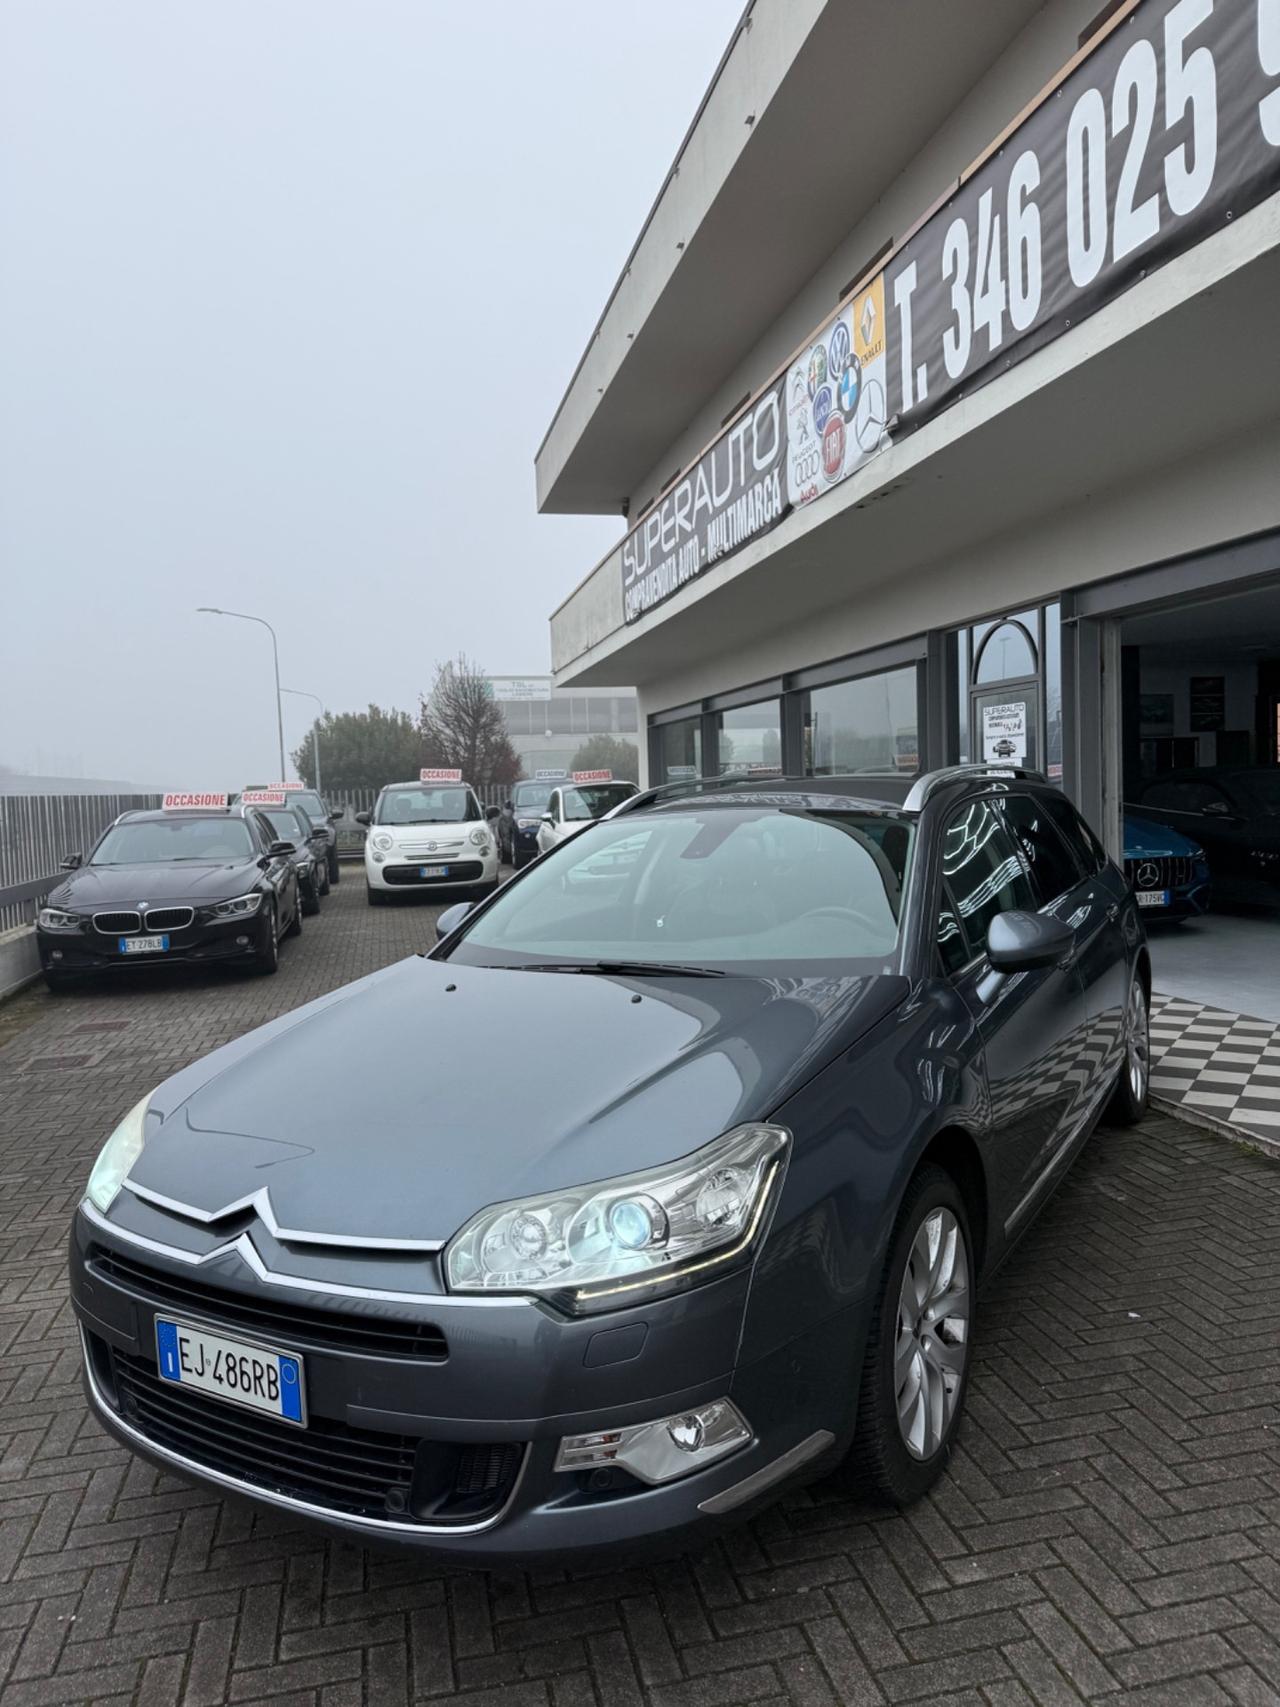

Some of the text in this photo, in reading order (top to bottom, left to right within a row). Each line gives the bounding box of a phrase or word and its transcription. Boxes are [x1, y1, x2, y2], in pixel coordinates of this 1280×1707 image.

[895, 261, 928, 412] T.
[942, 150, 1042, 379] 346
[1066, 0, 1217, 288] 025
[623, 391, 780, 586] SUPERAUTO
[707, 467, 782, 563] MULTIMARCA
[165, 794, 226, 806] OCCASIONE
[243, 793, 284, 802] OCCASIONE
[179, 1337, 205, 1377] EJ
[212, 1350, 280, 1401] 486RB
